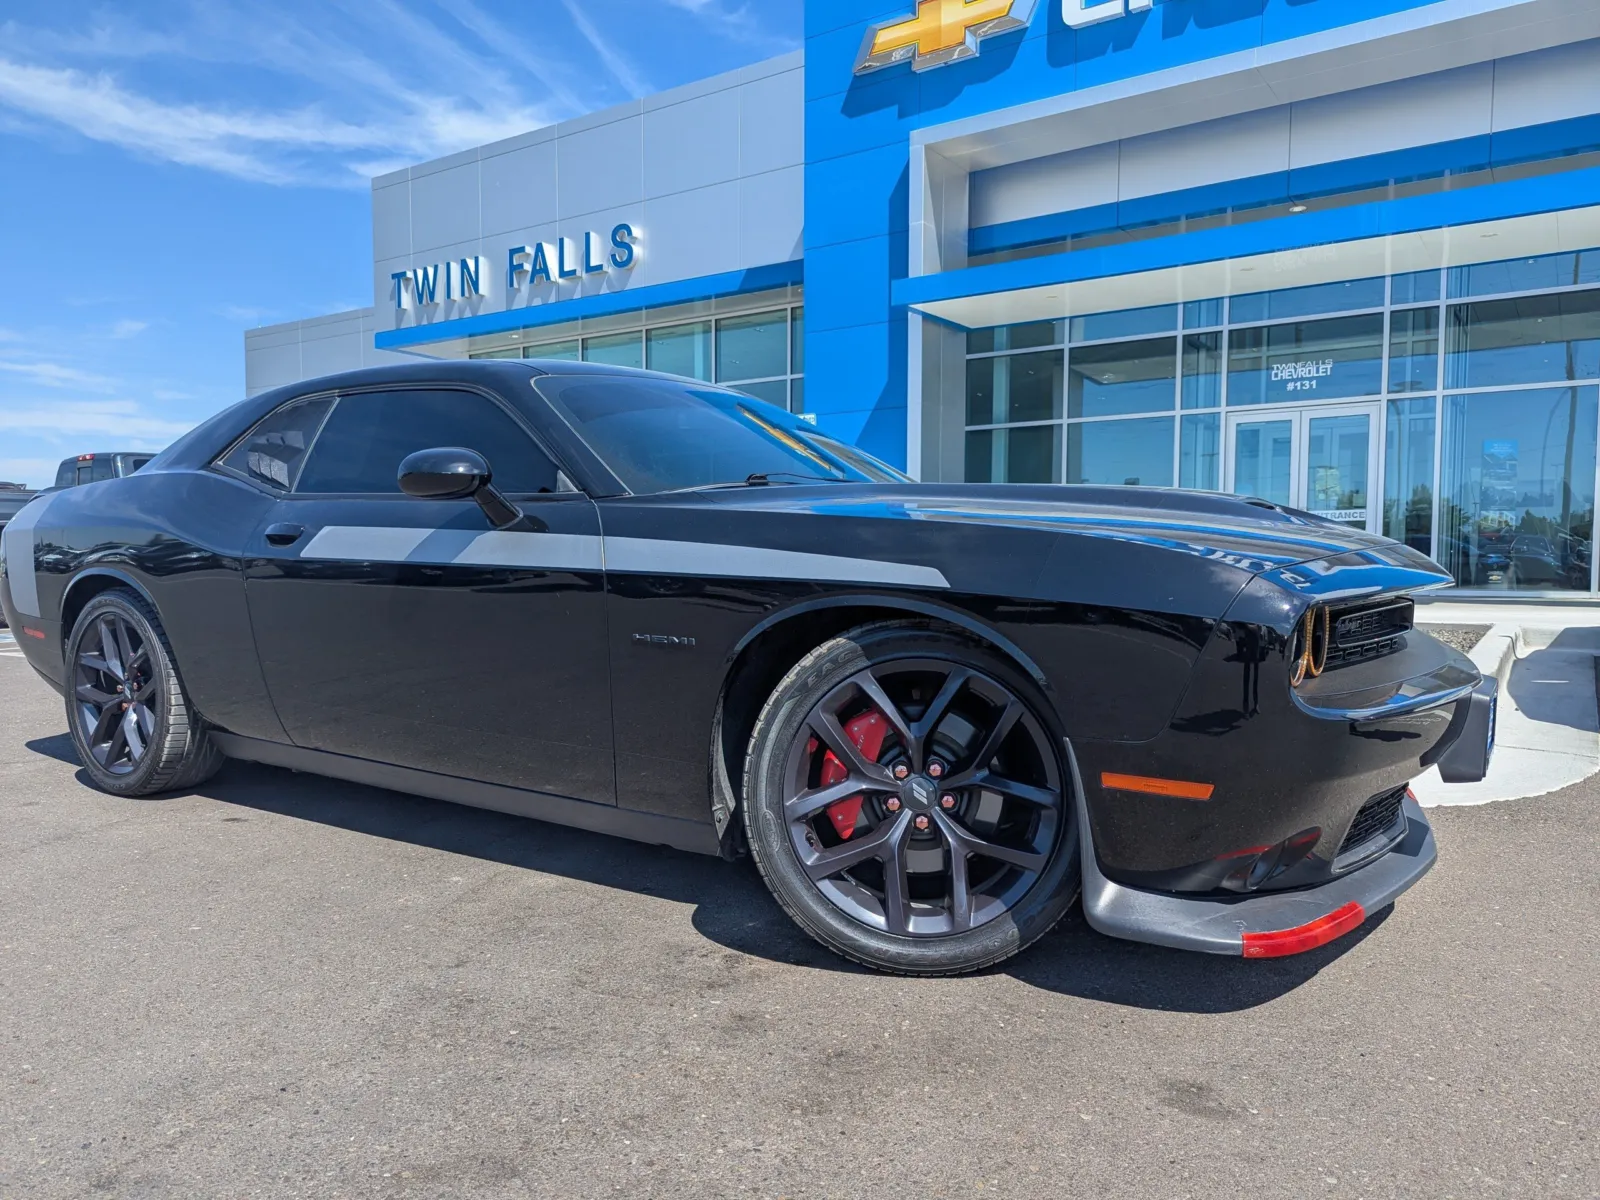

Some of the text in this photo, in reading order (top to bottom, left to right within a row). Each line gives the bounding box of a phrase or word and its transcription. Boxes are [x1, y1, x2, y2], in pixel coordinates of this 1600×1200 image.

[391, 223, 638, 309] TWIN FALLS
[1272, 365, 1332, 380] CHEVROLET
[1286, 380, 1317, 391] #131
[1316, 511, 1365, 519] TRANCE
[633, 633, 696, 646] HEMI
